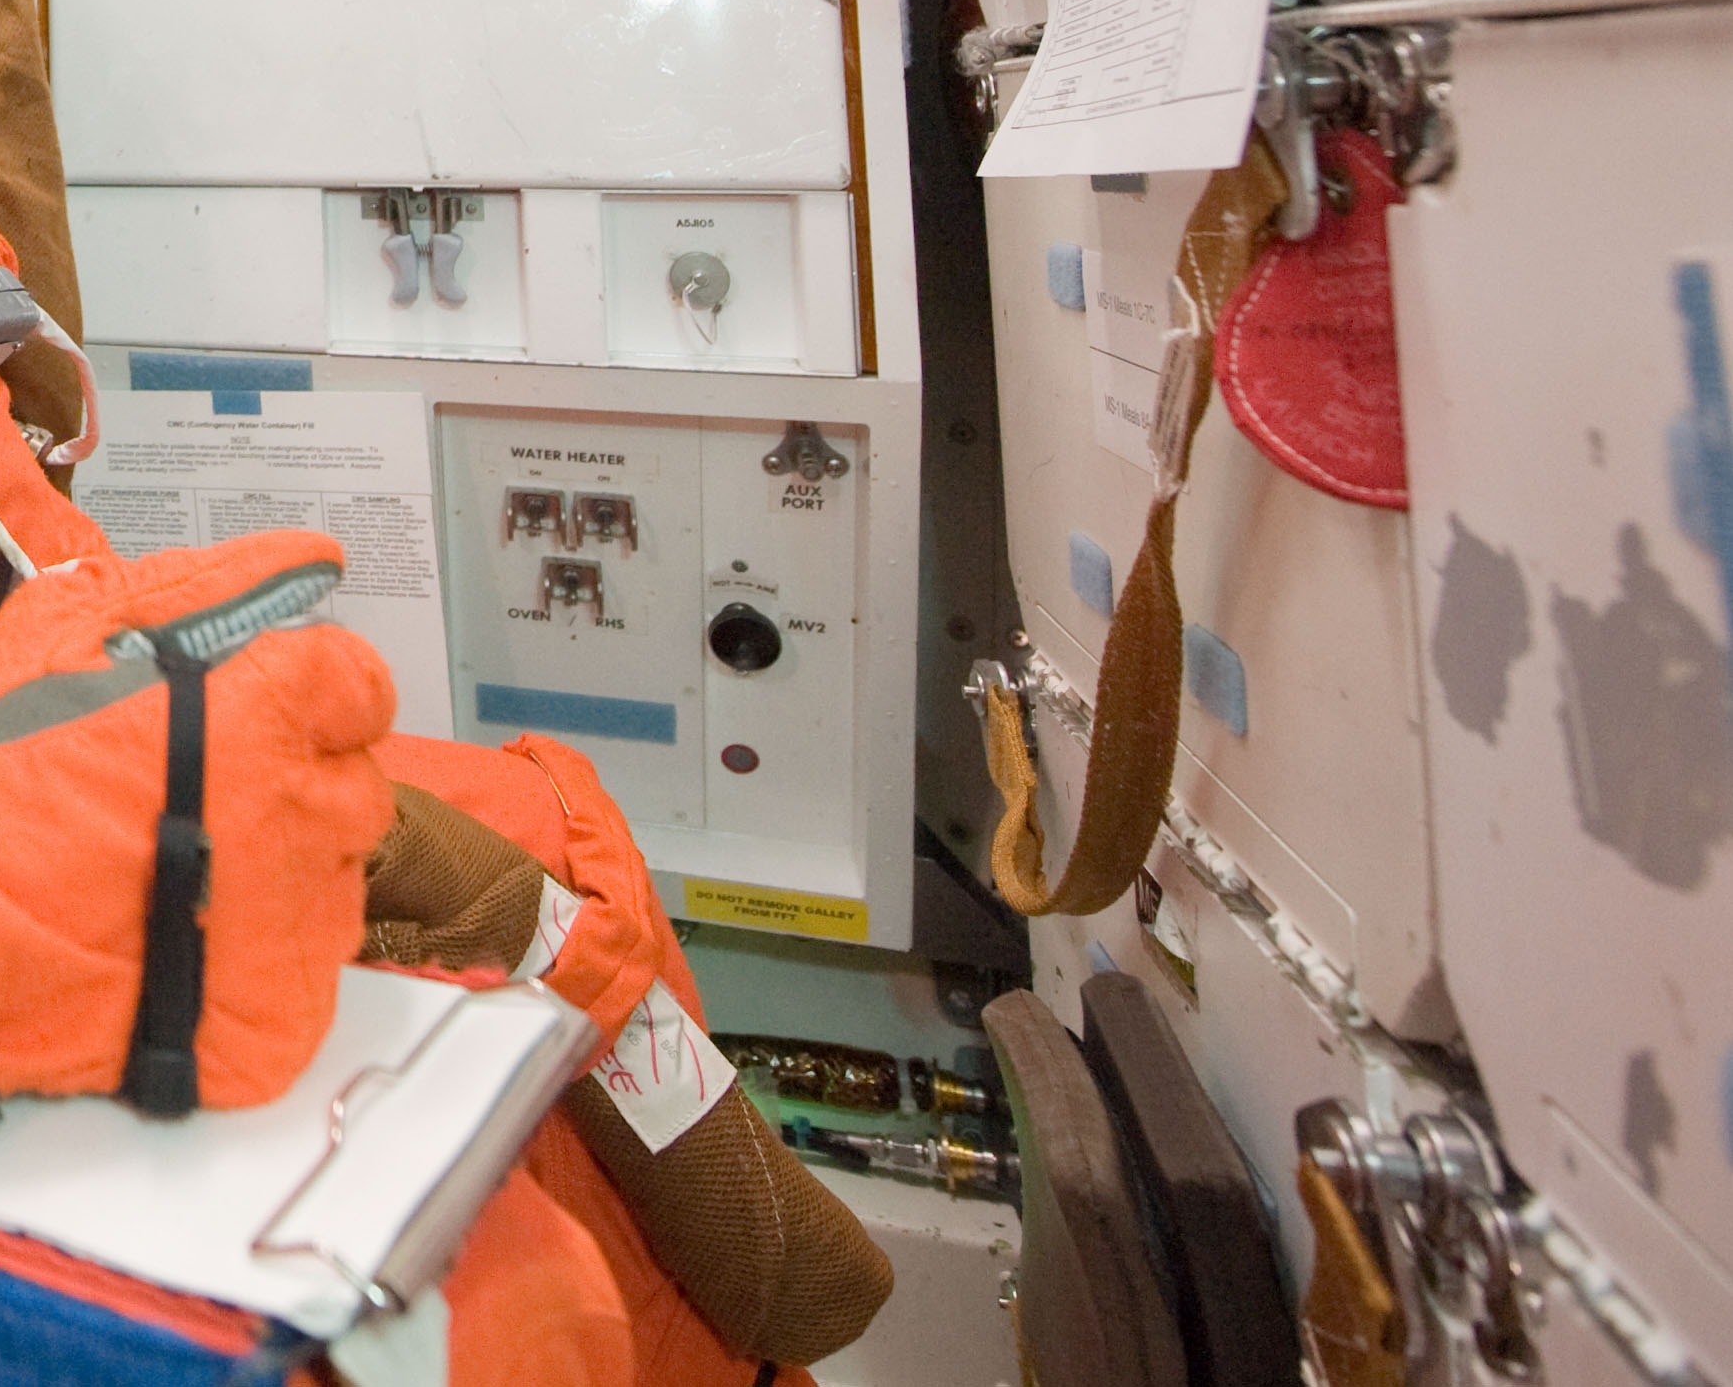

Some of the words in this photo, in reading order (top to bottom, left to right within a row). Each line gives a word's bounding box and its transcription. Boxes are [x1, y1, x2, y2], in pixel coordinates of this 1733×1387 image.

[511, 447, 562, 462] WATER
[567, 451, 626, 466] HEATER
[785, 484, 822, 497] AUX
[782, 497, 825, 511] PORT
[508, 607, 551, 622] OVEN
[596, 617, 625, 630] RHS
[788, 619, 826, 634] MV2
[696, 890, 713, 900] DO
[717, 893, 743, 903] NOT
[748, 898, 801, 913] REMOVE
[804, 905, 856, 921] GALLEY
[734, 906, 770, 918] FROM
